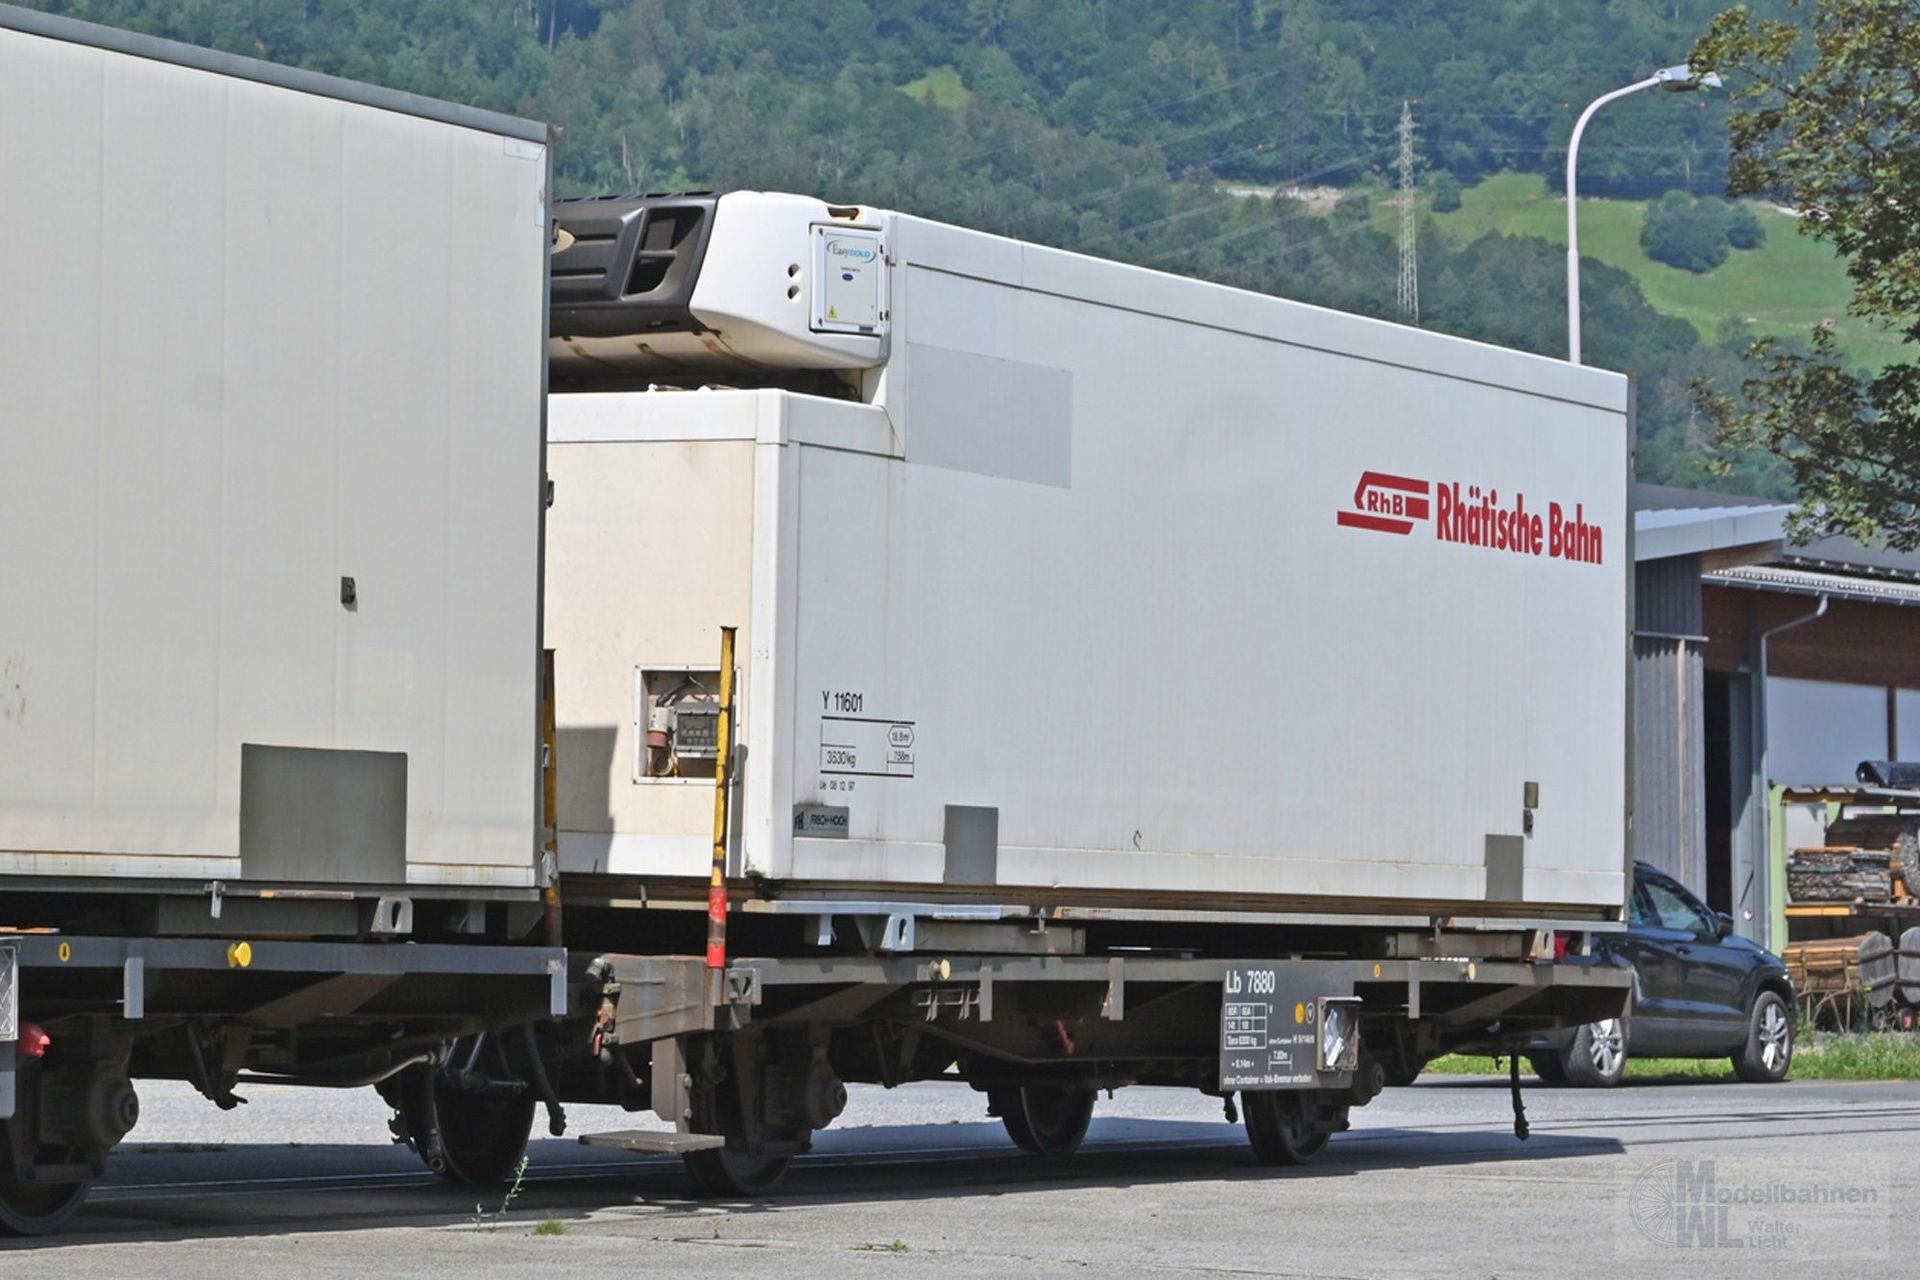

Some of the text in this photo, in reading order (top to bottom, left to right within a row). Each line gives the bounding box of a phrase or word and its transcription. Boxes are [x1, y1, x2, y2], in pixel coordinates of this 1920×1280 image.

[1367, 490, 1404, 516] RhB
[1436, 481, 1603, 565] Rhätische Bahn
[822, 690, 863, 712] Y 11601
[1226, 970, 1275, 993] Lb 7880
